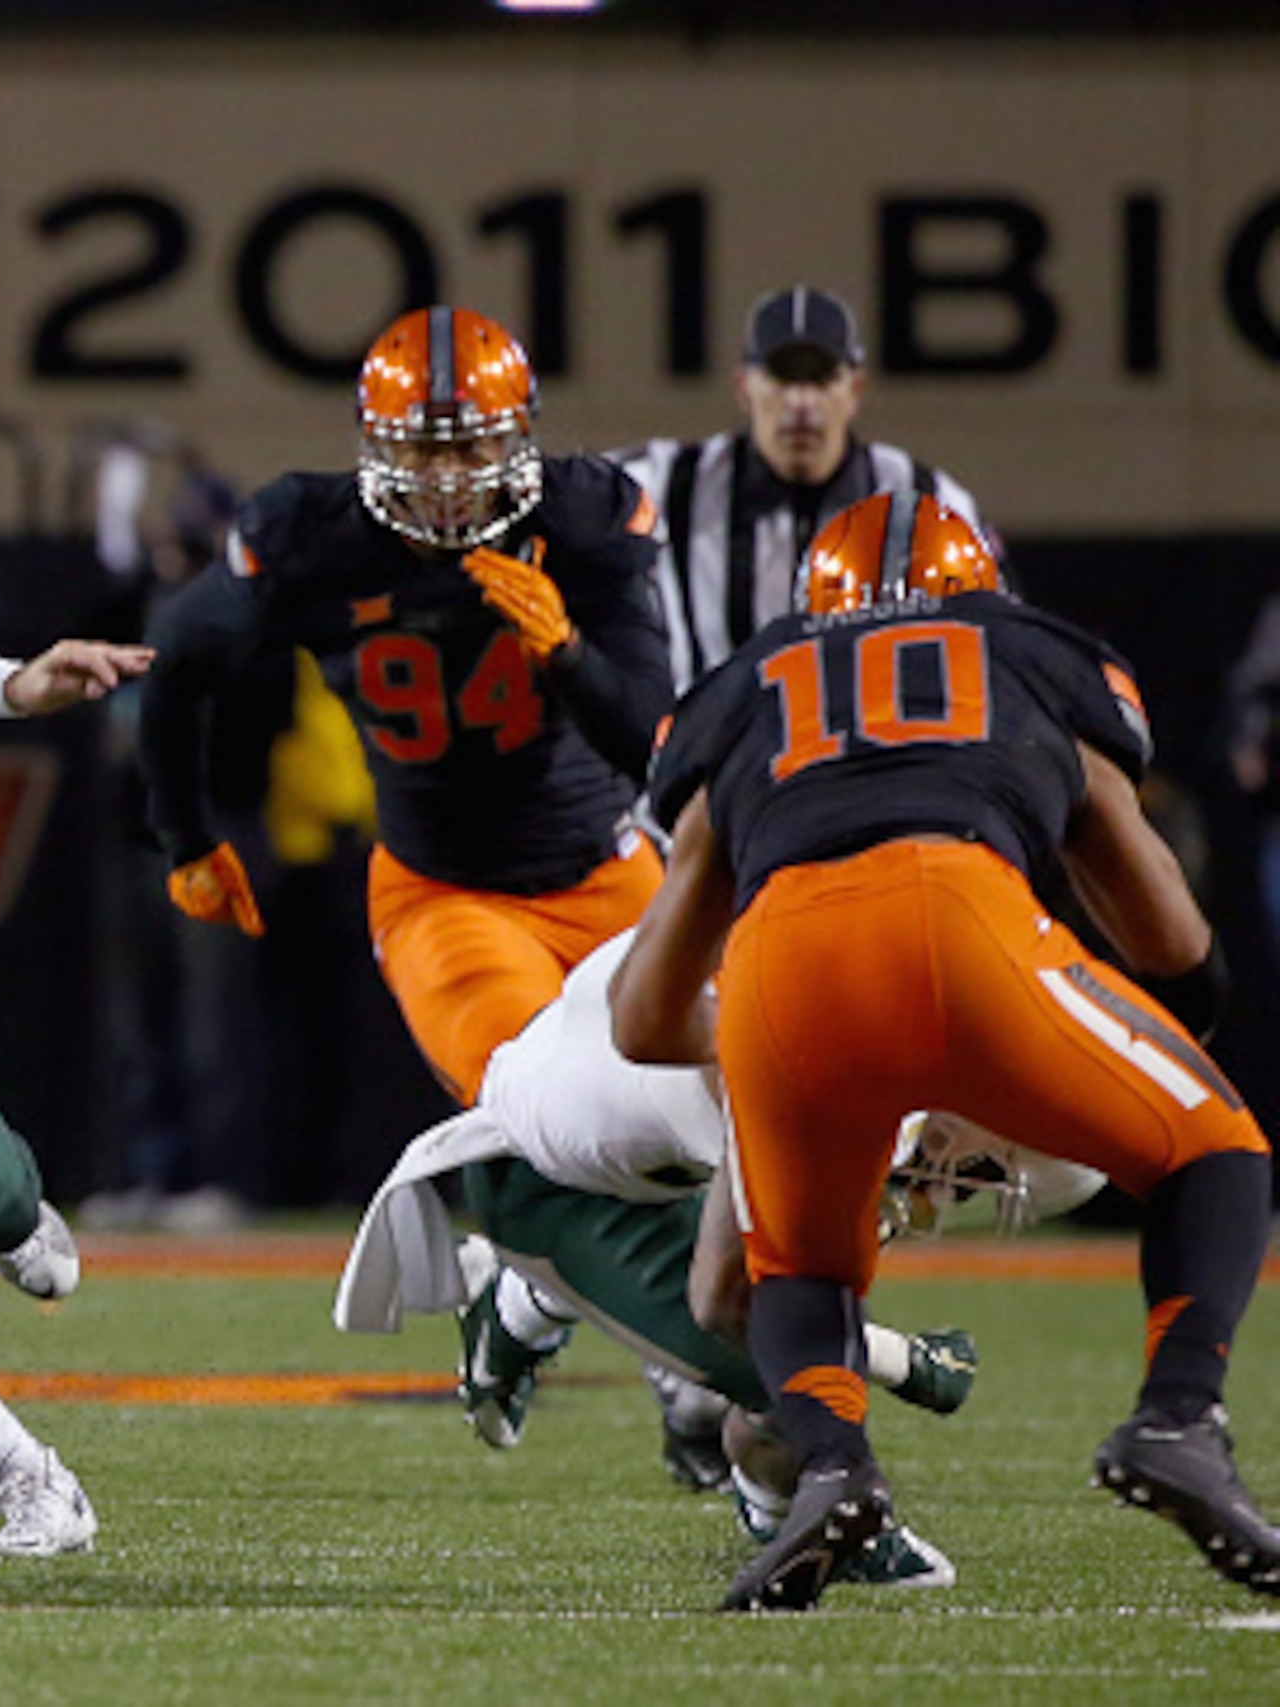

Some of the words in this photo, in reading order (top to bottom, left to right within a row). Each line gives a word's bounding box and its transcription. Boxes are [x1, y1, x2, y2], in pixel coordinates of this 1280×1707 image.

[29, 185, 710, 383] 2011
[878, 185, 1280, 378] BI
[356, 630, 544, 762] 94
[759, 620, 990, 783] 10
